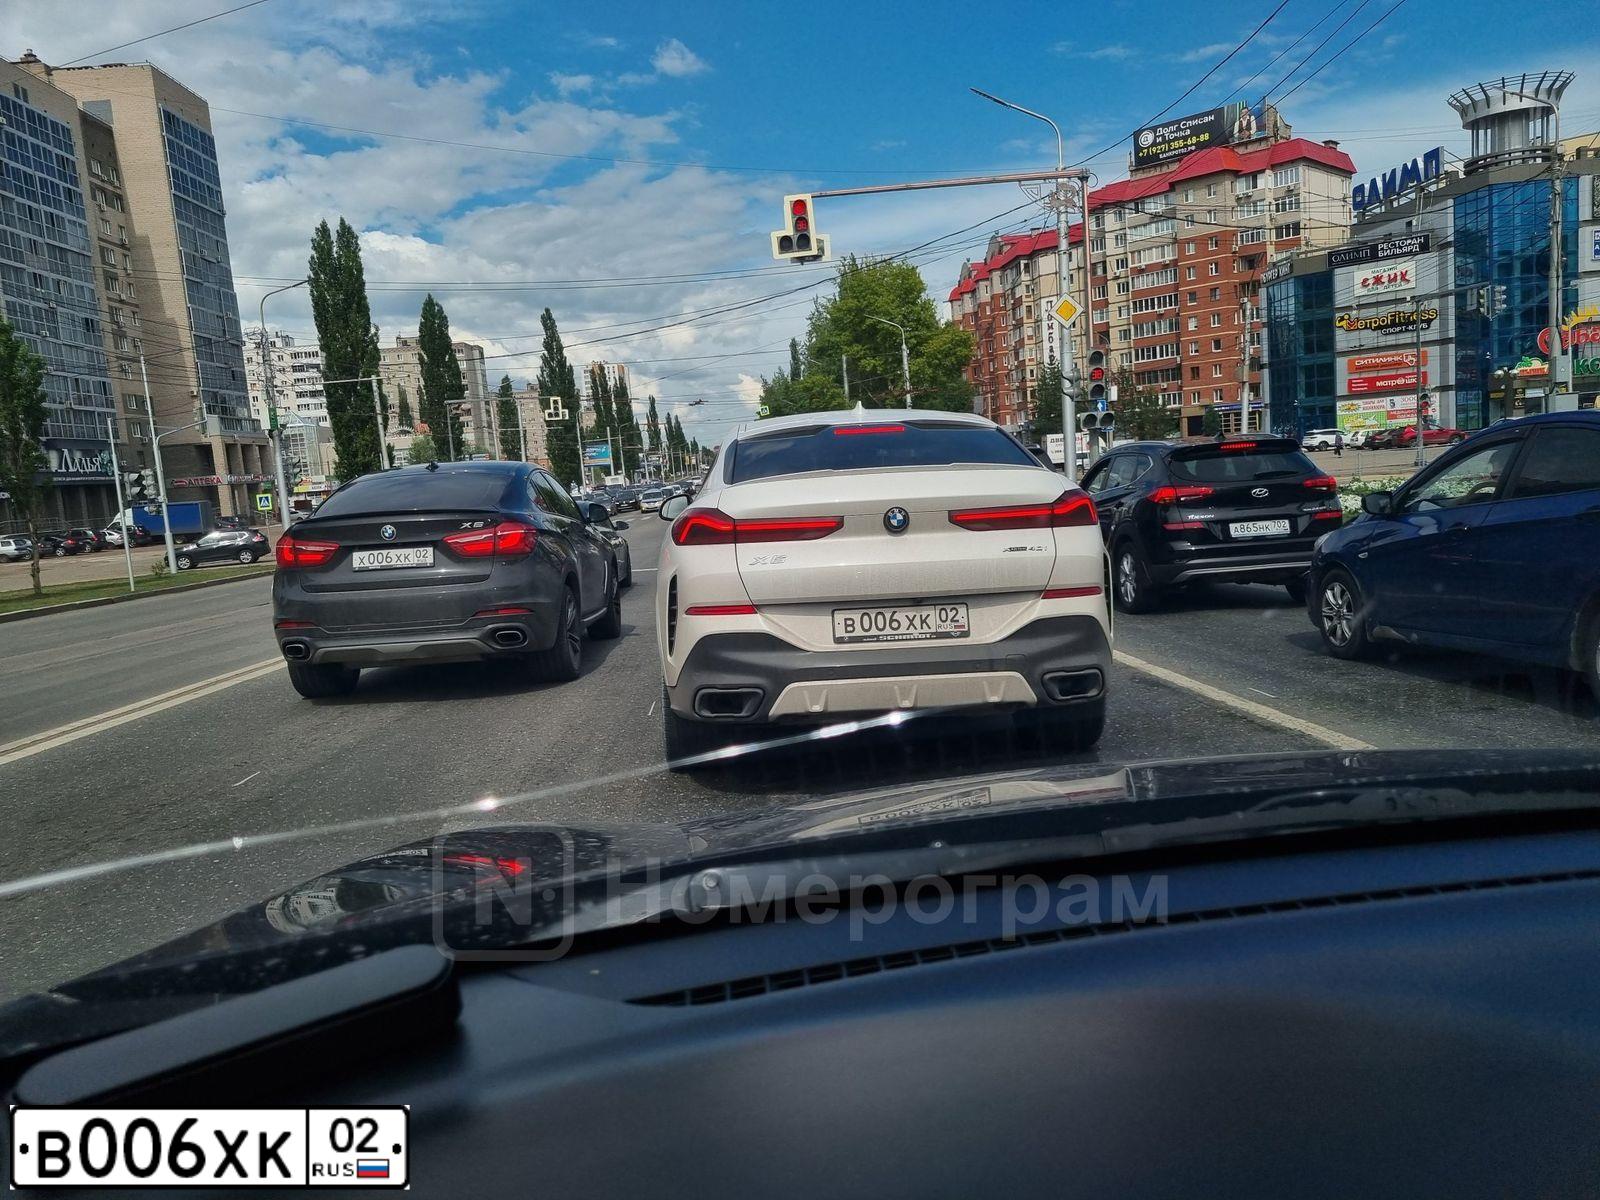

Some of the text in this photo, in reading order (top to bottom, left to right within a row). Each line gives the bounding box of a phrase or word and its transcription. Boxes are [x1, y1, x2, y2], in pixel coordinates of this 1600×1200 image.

[1156, 114, 1215, 136] Долг Списан
[1165, 128, 1191, 140] Точка
[1138, 132, 1210, 157] +7 (927) 355-68-88
[1352, 146, 1443, 211] ОЛИМП
[1378, 236, 1424, 251] РЕСТОРАН
[1378, 244, 1420, 257] БИЛЬЯРД
[1331, 249, 1371, 263] ОЛИМП
[1355, 355, 1403, 366] СИТИЛИНК
[57, 448, 102, 474] Ладья
[187, 475, 223, 488] АПТЕКА
[460, 521, 484, 529] X6
[1234, 520, 1287, 533] А865НК 702
[358, 549, 428, 566] Х006ХК 02
[844, 607, 960, 633] В006ХК 02
